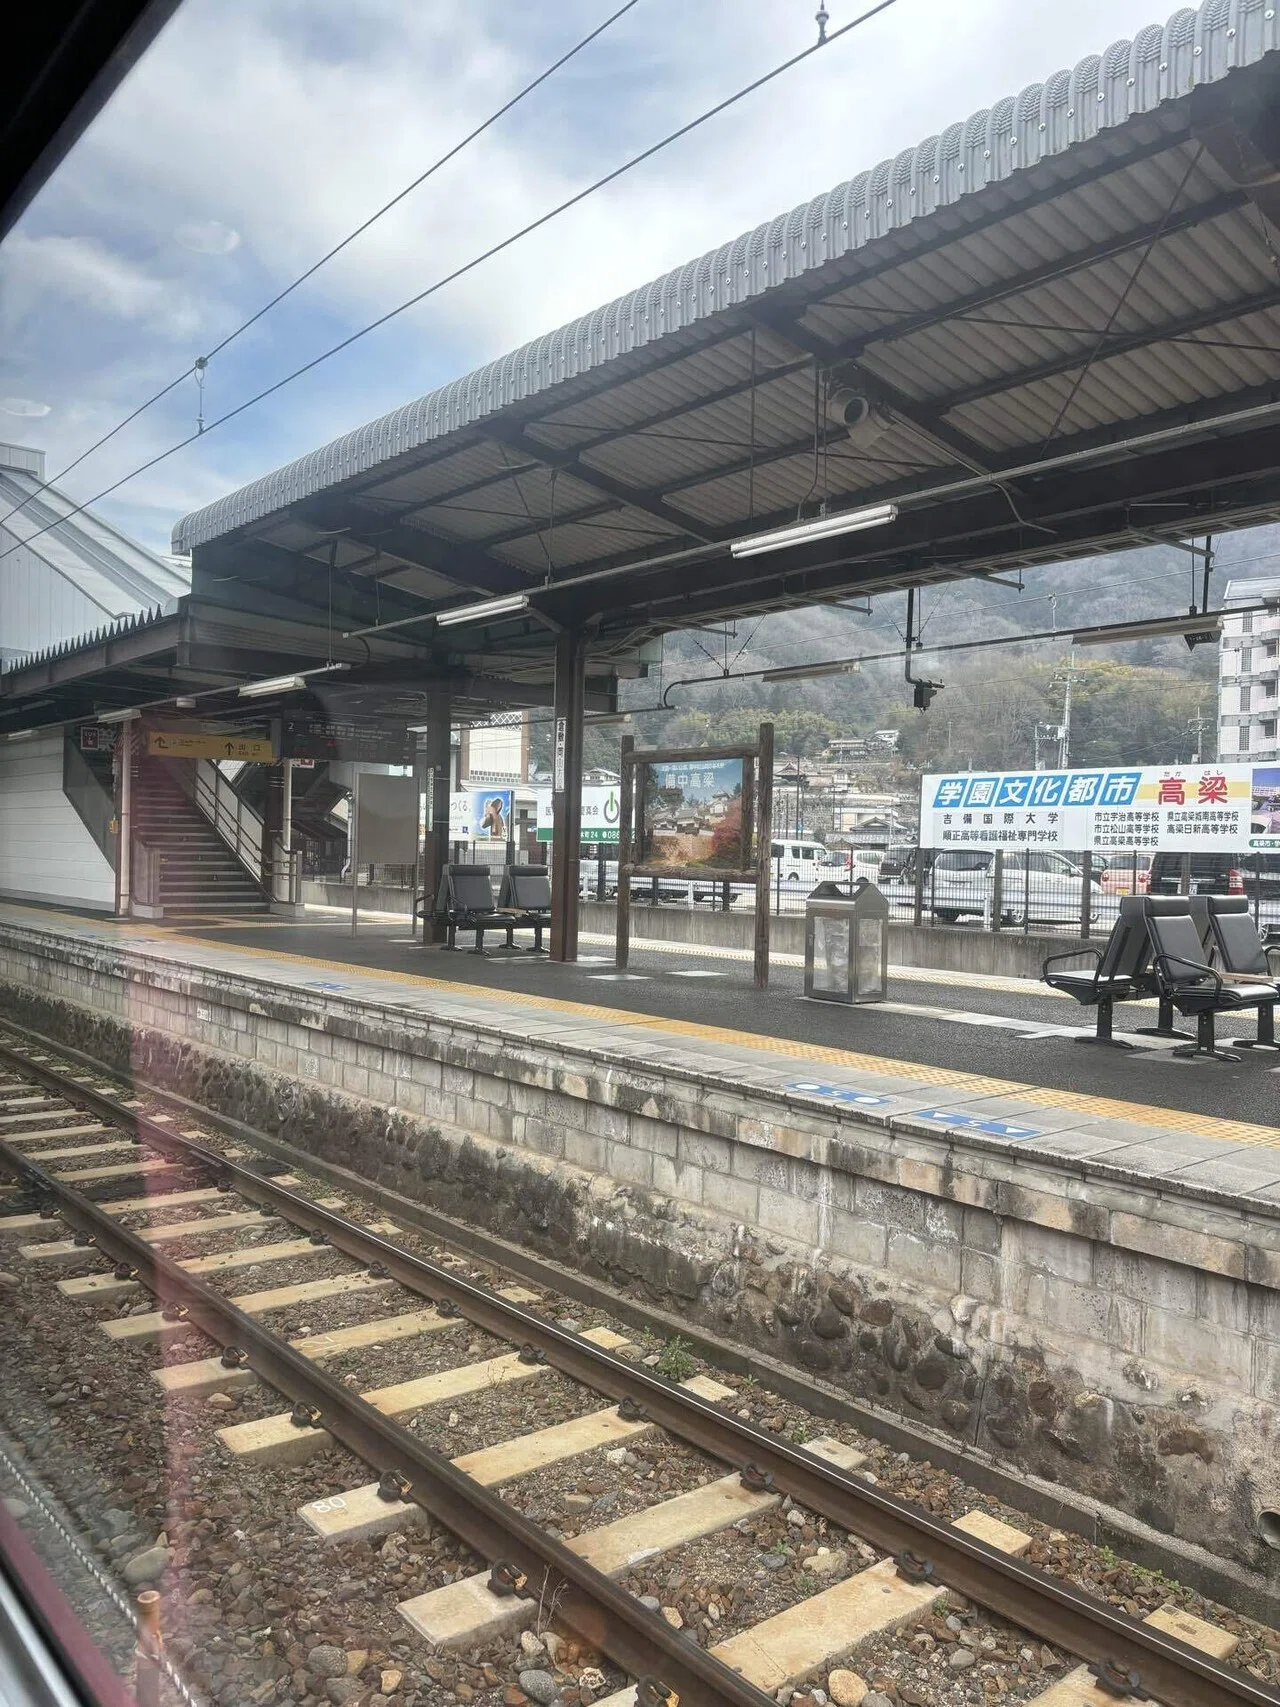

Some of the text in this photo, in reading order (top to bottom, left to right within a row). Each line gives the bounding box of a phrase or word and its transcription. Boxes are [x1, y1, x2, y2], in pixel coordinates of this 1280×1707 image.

[665, 772, 714, 789] 備中高梁
[938, 776, 1228, 805] 学園文化都市 高梁
[943, 812, 1058, 825] 吉備国際大学
[1094, 812, 1159, 822] 市立宇治高等学校
[1094, 824, 1238, 834] 市立松山高等学校 高梁日新高等学校
[942, 830, 1058, 842] 順正高等看護福祉専門学校
[1094, 836, 1159, 846] 県立高梁高等学校
